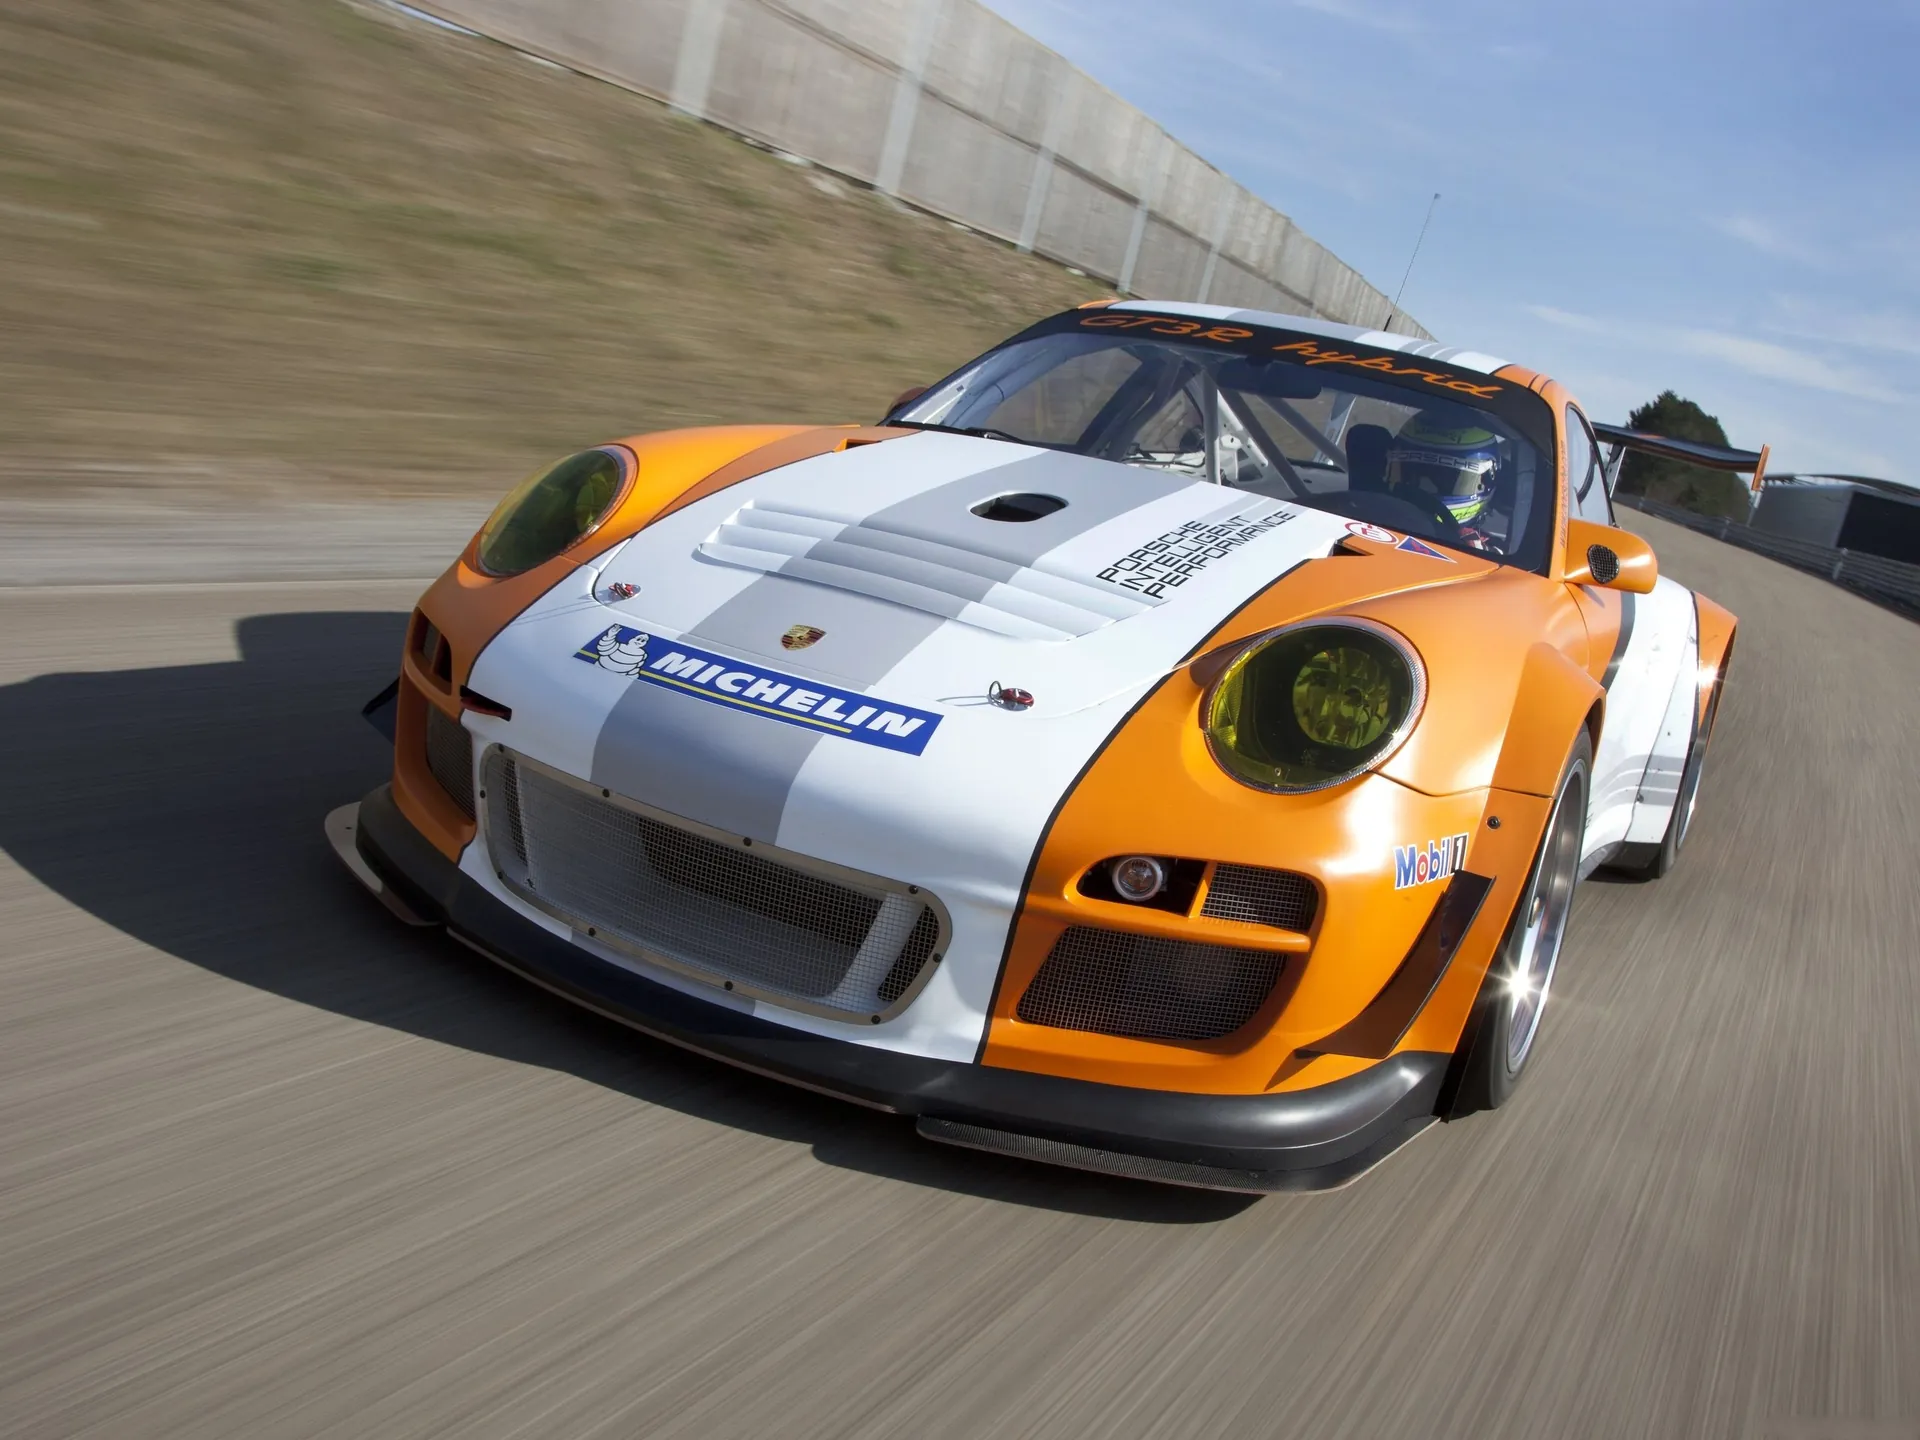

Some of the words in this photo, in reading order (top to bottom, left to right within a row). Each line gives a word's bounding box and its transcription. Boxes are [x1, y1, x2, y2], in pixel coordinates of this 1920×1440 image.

[1080, 315, 1253, 342] GT3R
[1272, 341, 1503, 399] hybrid
[1096, 520, 1209, 583] PORSCHE
[1119, 515, 1251, 591] INTELLIGENT
[1142, 511, 1296, 600] PERFORMANCE
[650, 651, 927, 738] MICHELIN
[1393, 837, 1451, 889] Mobil
